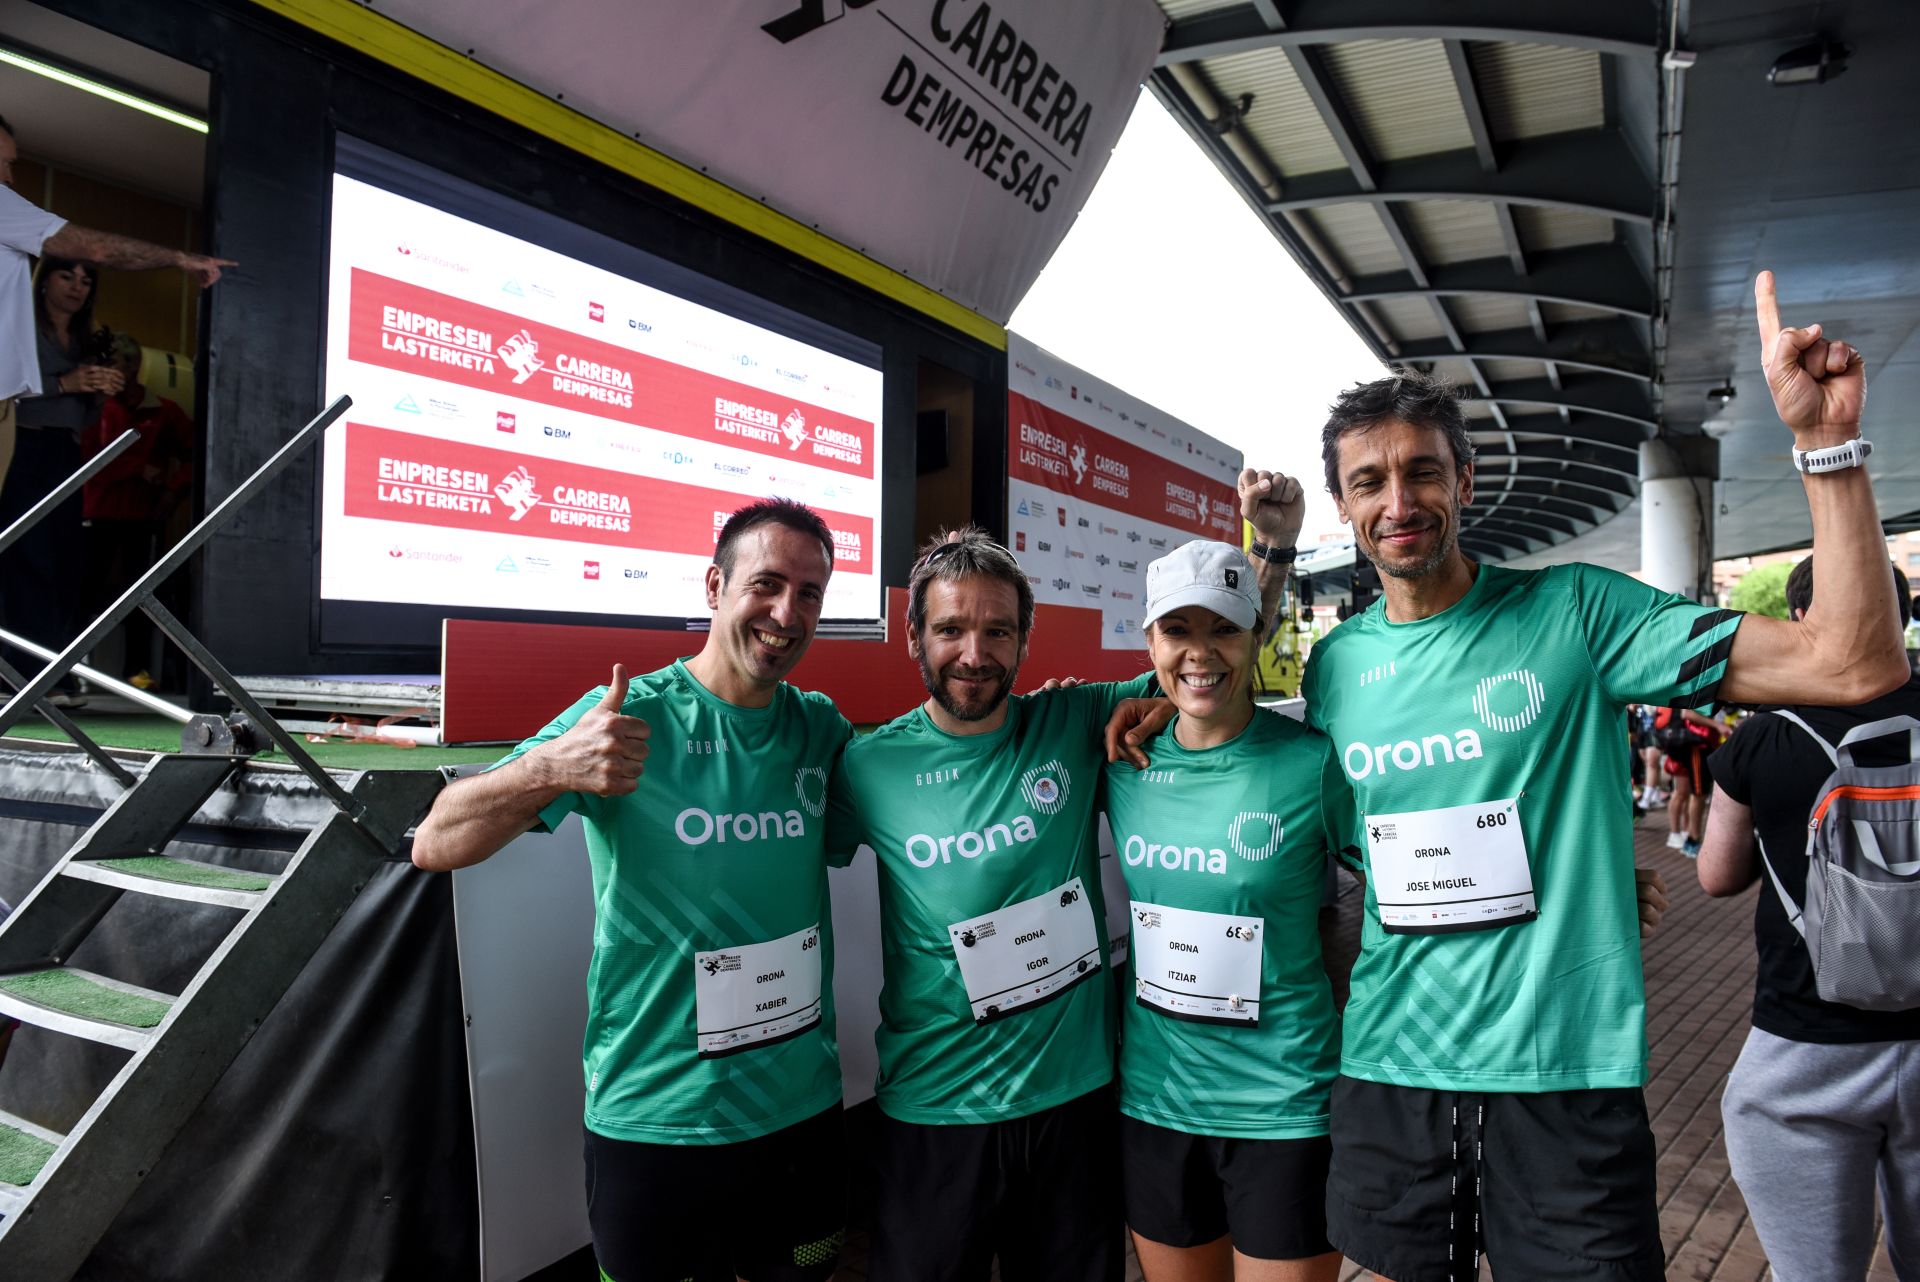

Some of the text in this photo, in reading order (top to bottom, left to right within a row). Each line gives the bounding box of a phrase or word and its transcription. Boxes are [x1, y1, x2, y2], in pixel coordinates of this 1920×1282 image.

[931, 0, 1092, 156] CARRERA
[881, 55, 1059, 212] DEMPRESAS
[383, 305, 492, 352] ENPRESEN
[382, 332, 495, 375] LASTERKETA
[556, 353, 633, 390] CARRERA
[553, 375, 632, 408] DEMPRESAS
[715, 397, 778, 428] ENPRESEN
[714, 418, 780, 445] LASTERKETA
[815, 425, 862, 450] CARRERA
[1021, 423, 1067, 458] ENPRESEN
[379, 457, 488, 493] ENPRESEN
[1020, 448, 1069, 477] LASTERKETA
[1094, 454, 1129, 481] CARRERA
[378, 484, 491, 514] LASTERKETA
[553, 485, 631, 514] CARRERA
[550, 508, 630, 533] DEMPRESAS
[1360, 661, 1396, 687] GOBIK
[687, 739, 730, 754] GOBIK
[1344, 728, 1483, 780] Orona
[916, 768, 959, 786] GOBIK
[675, 807, 805, 845] Orona
[1476, 812, 1507, 829] 680
[905, 815, 1037, 868] Orona
[1125, 834, 1227, 874] Orona
[1415, 846, 1451, 858] ORONA
[1406, 877, 1477, 892] JOSE MIGUEL
[802, 935, 818, 951] 680
[1014, 929, 1046, 946] ORONA
[1169, 941, 1199, 954] ORONA
[756, 970, 785, 984] ORONA
[1027, 957, 1049, 971] IGOR
[1168, 970, 1197, 983] ITZIAR
[755, 997, 787, 1013] XABIER
